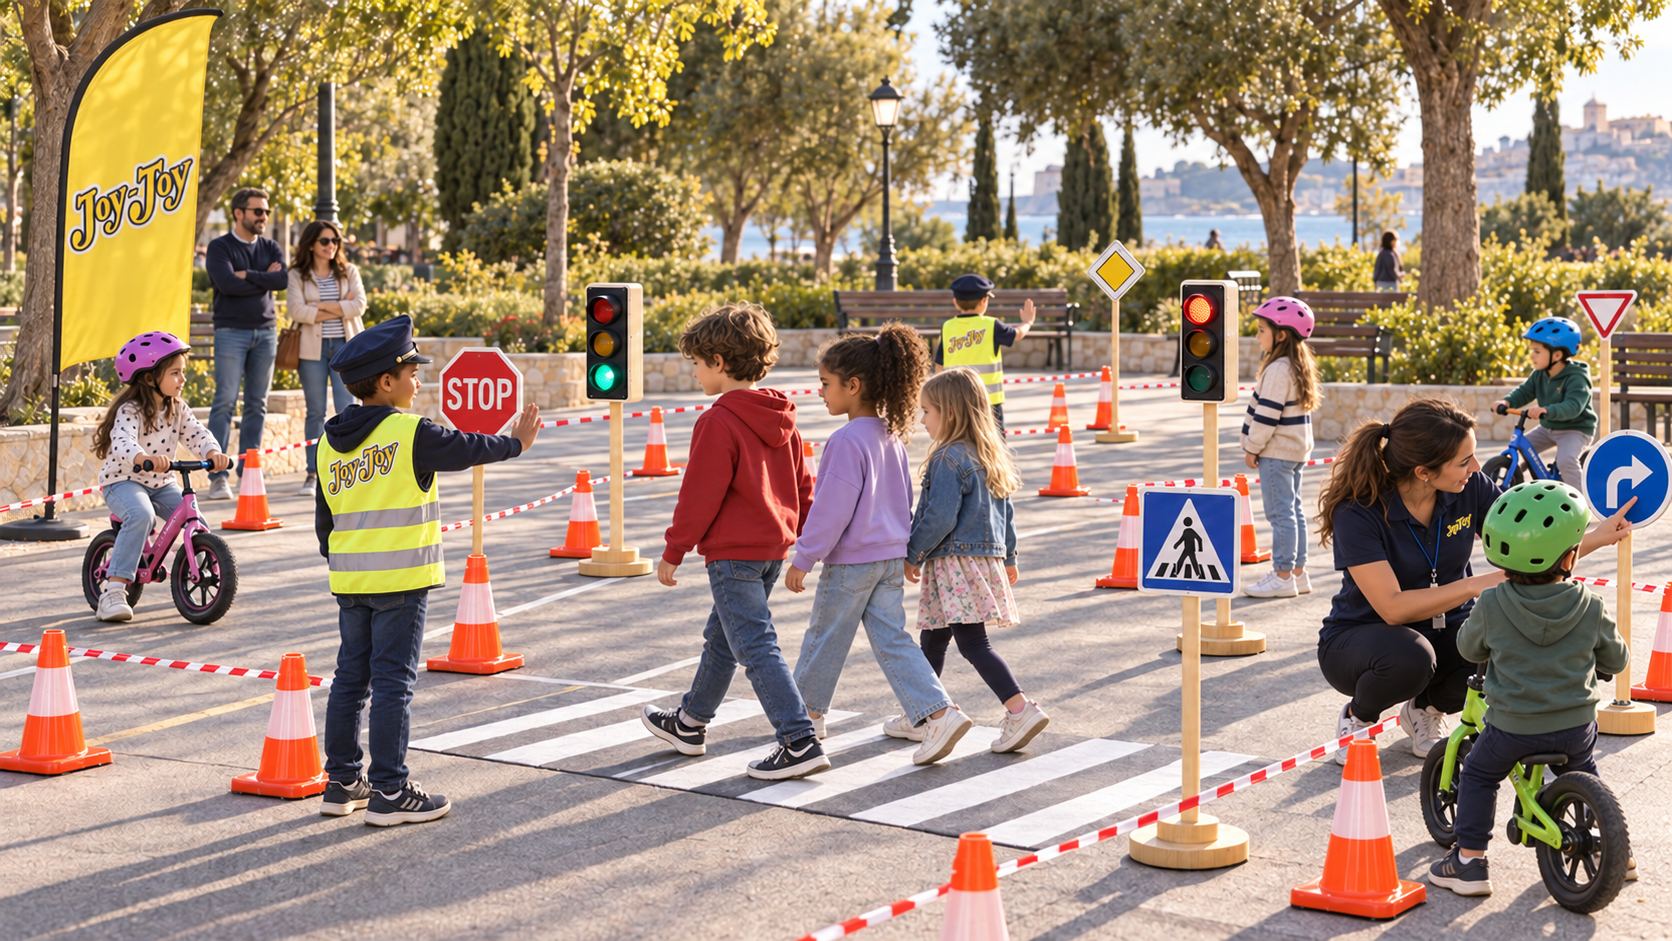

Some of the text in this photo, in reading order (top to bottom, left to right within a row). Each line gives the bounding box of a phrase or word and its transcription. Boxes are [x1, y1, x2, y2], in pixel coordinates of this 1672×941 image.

[69, 157, 194, 252] Joy-Joy
[447, 377, 513, 411] STOP
[328, 441, 399, 495] Joy-Joy
